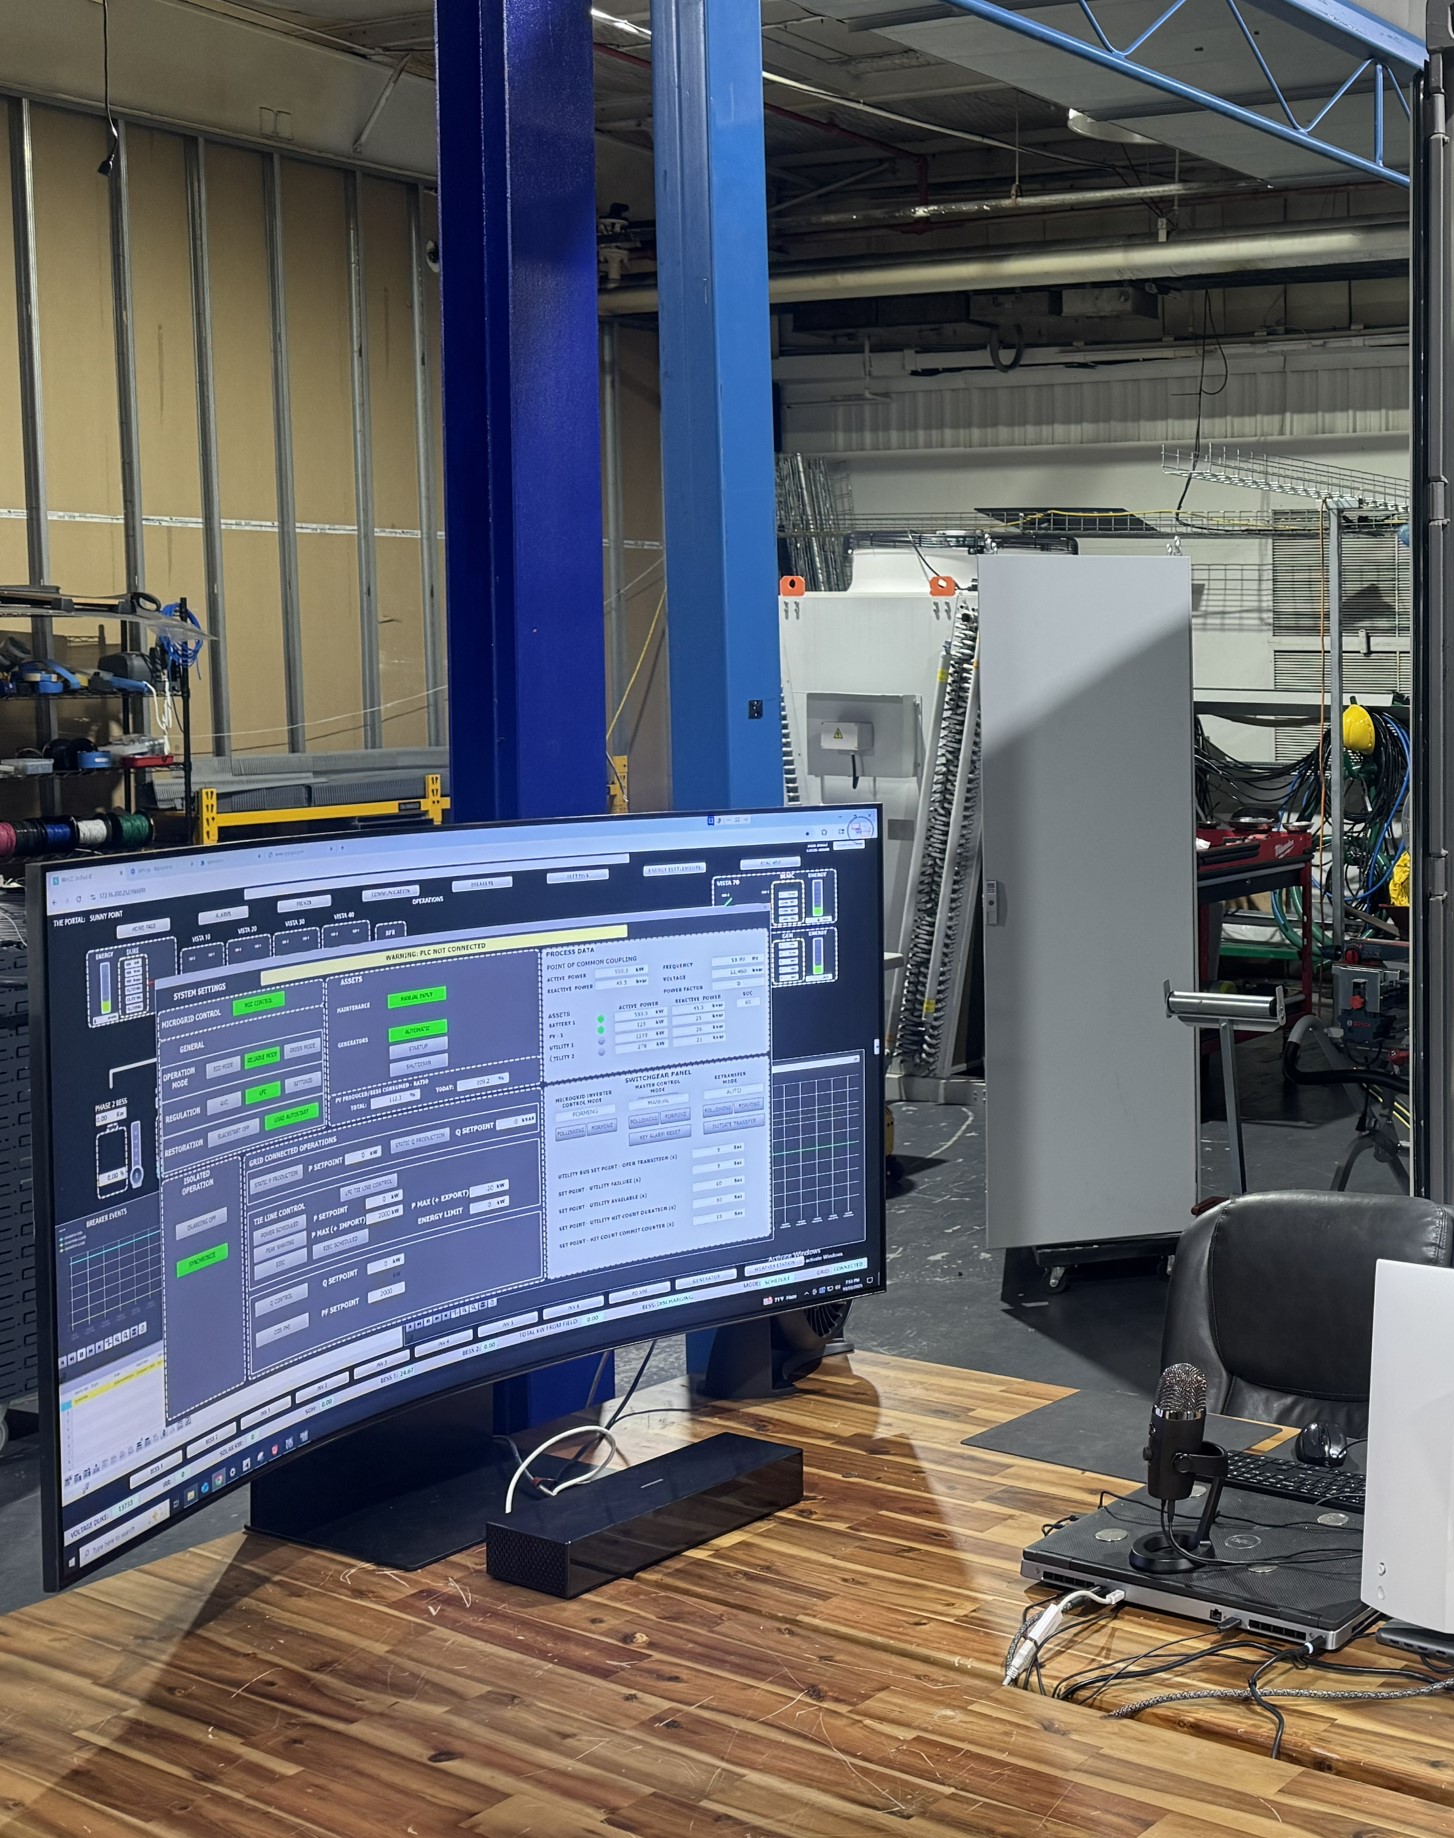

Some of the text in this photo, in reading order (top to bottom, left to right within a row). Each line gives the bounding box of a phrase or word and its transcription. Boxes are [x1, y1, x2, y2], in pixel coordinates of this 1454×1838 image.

[386, 951, 417, 961] WARNING:
[448, 943, 486, 952] CONNECTED
[546, 947, 595, 957] PROCESS DATA
[576, 959, 604, 968] COMMON
[606, 956, 637, 965] COUPLING
[341, 976, 362, 985] ASSETS
[174, 983, 226, 1000] SYSTEM SETTINGS
[162, 1009, 221, 1029] MICROGRID CONTROL
[180, 1041, 204, 1053] GENERAL
[163, 1067, 195, 1081] OPERATION
[625, 1073, 668, 1084] SWITCHGEAR
[172, 1080, 188, 1089] MODE
[166, 1107, 200, 1123] REGULATION
[462, 1122, 494, 1135] SETPOINT
[165, 1139, 203, 1157] RESTORATION
[249, 1136, 337, 1166] GRID CONNECTED OPERATIONS
[314, 1157, 343, 1170] SETPOINT
[184, 1170, 210, 1185] ISOLATED
[182, 1179, 214, 1195] OPERATION
[254, 1203, 306, 1225] TIE LINE CONTROL
[319, 1205, 348, 1220] SETPOINT
[418, 1207, 463, 1225] ENERGY LIMIT
[329, 1269, 358, 1285] SETPOINT
[330, 1298, 360, 1314] SETPOINT
